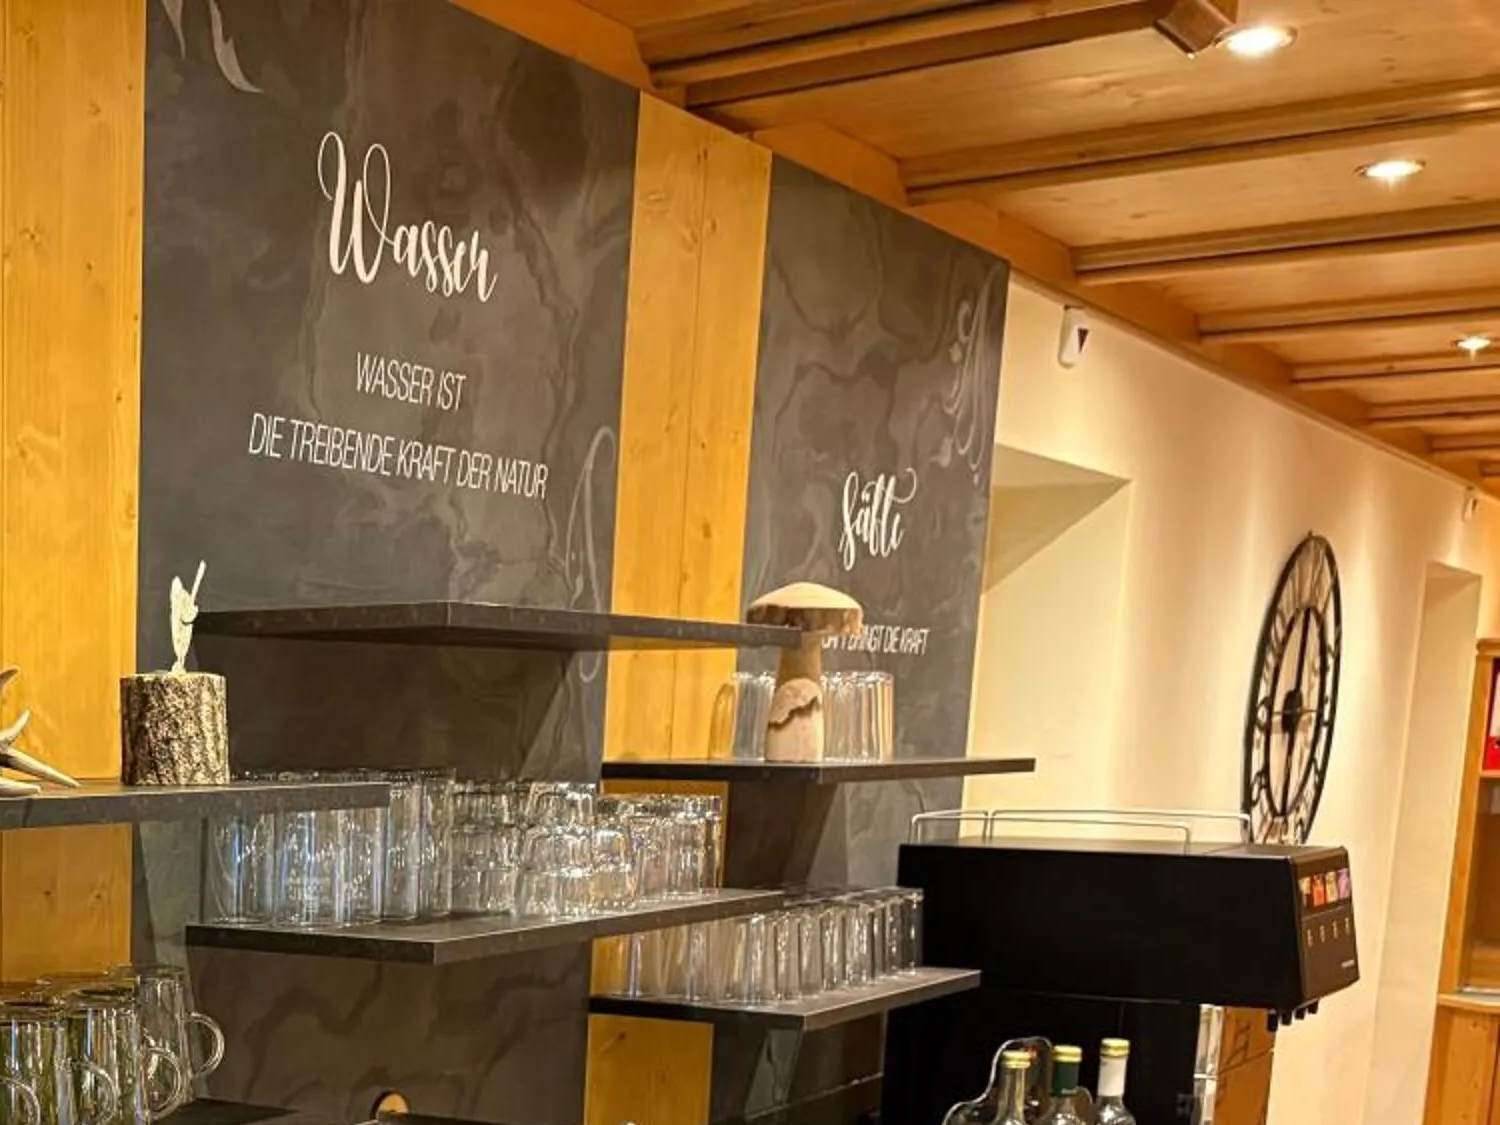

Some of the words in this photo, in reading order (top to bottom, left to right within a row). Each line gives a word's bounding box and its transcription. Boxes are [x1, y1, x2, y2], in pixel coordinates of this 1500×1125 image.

[317, 131, 499, 303] Wasser
[355, 351, 435, 405] WASSER
[436, 372, 466, 411] IST
[248, 412, 285, 460] DIE
[289, 419, 394, 477] TREIBENDE
[396, 438, 456, 484] KRAFT
[456, 449, 492, 491] DER
[493, 456, 549, 499] NATUR
